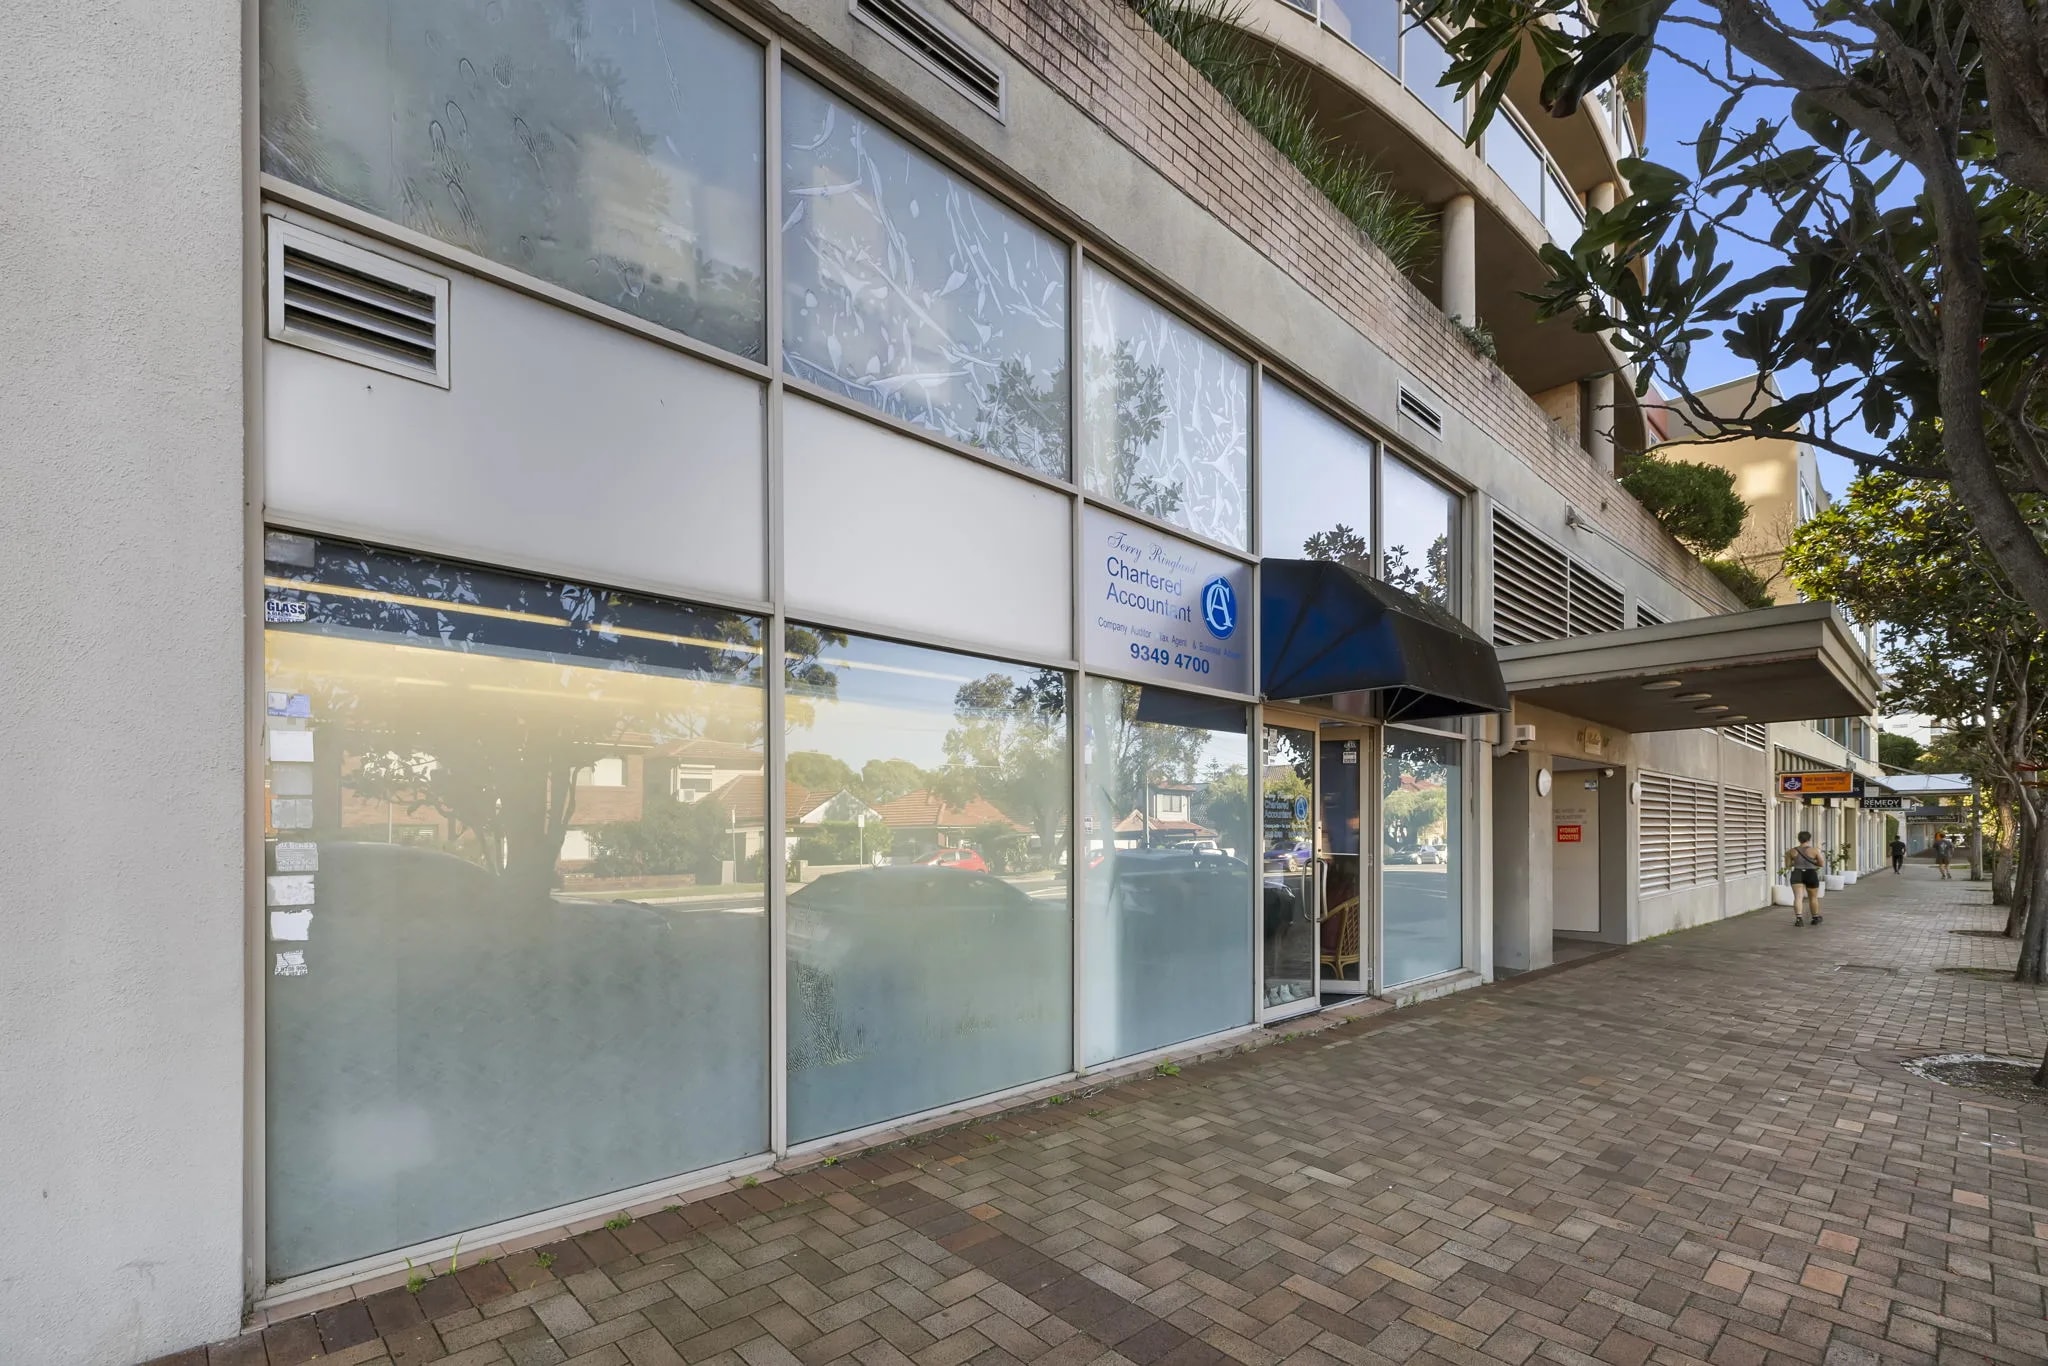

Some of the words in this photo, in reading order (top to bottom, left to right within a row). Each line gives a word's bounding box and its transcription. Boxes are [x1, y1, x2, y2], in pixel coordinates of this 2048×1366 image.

[1107, 531, 1142, 563] Terry
[1106, 556, 1182, 597] Chartered
[266, 601, 306, 615] GLASS
[1097, 616, 1128, 635] Company
[1171, 634, 1187, 648] Agent
[1130, 642, 1169, 666] 9349
[1174, 654, 1210, 674] 4700
